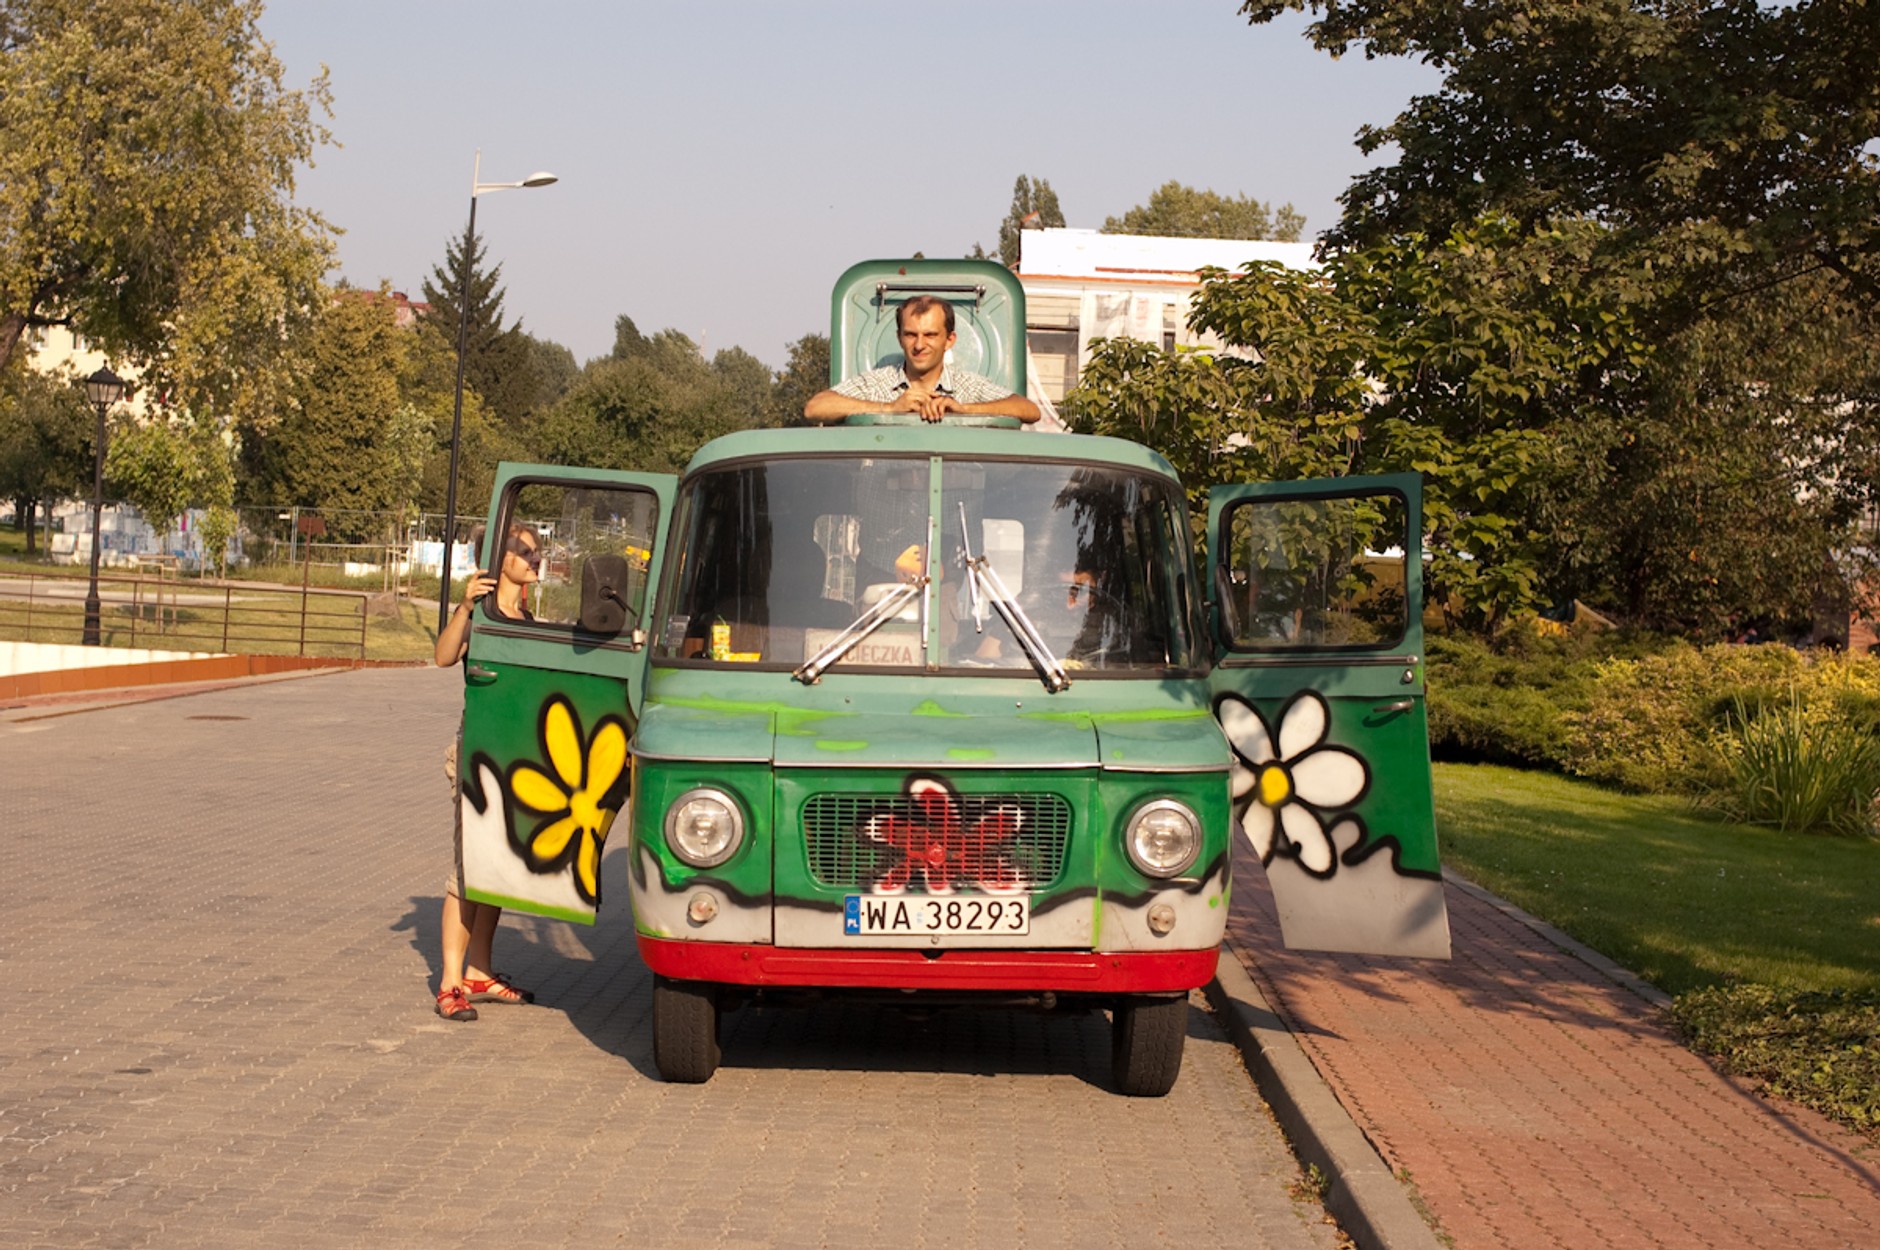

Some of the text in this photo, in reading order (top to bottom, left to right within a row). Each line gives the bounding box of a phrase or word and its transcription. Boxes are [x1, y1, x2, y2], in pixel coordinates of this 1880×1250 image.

[819, 643, 913, 664] CIECZKA
[847, 918, 859, 928] PL
[867, 901, 1024, 930] WA 38293
